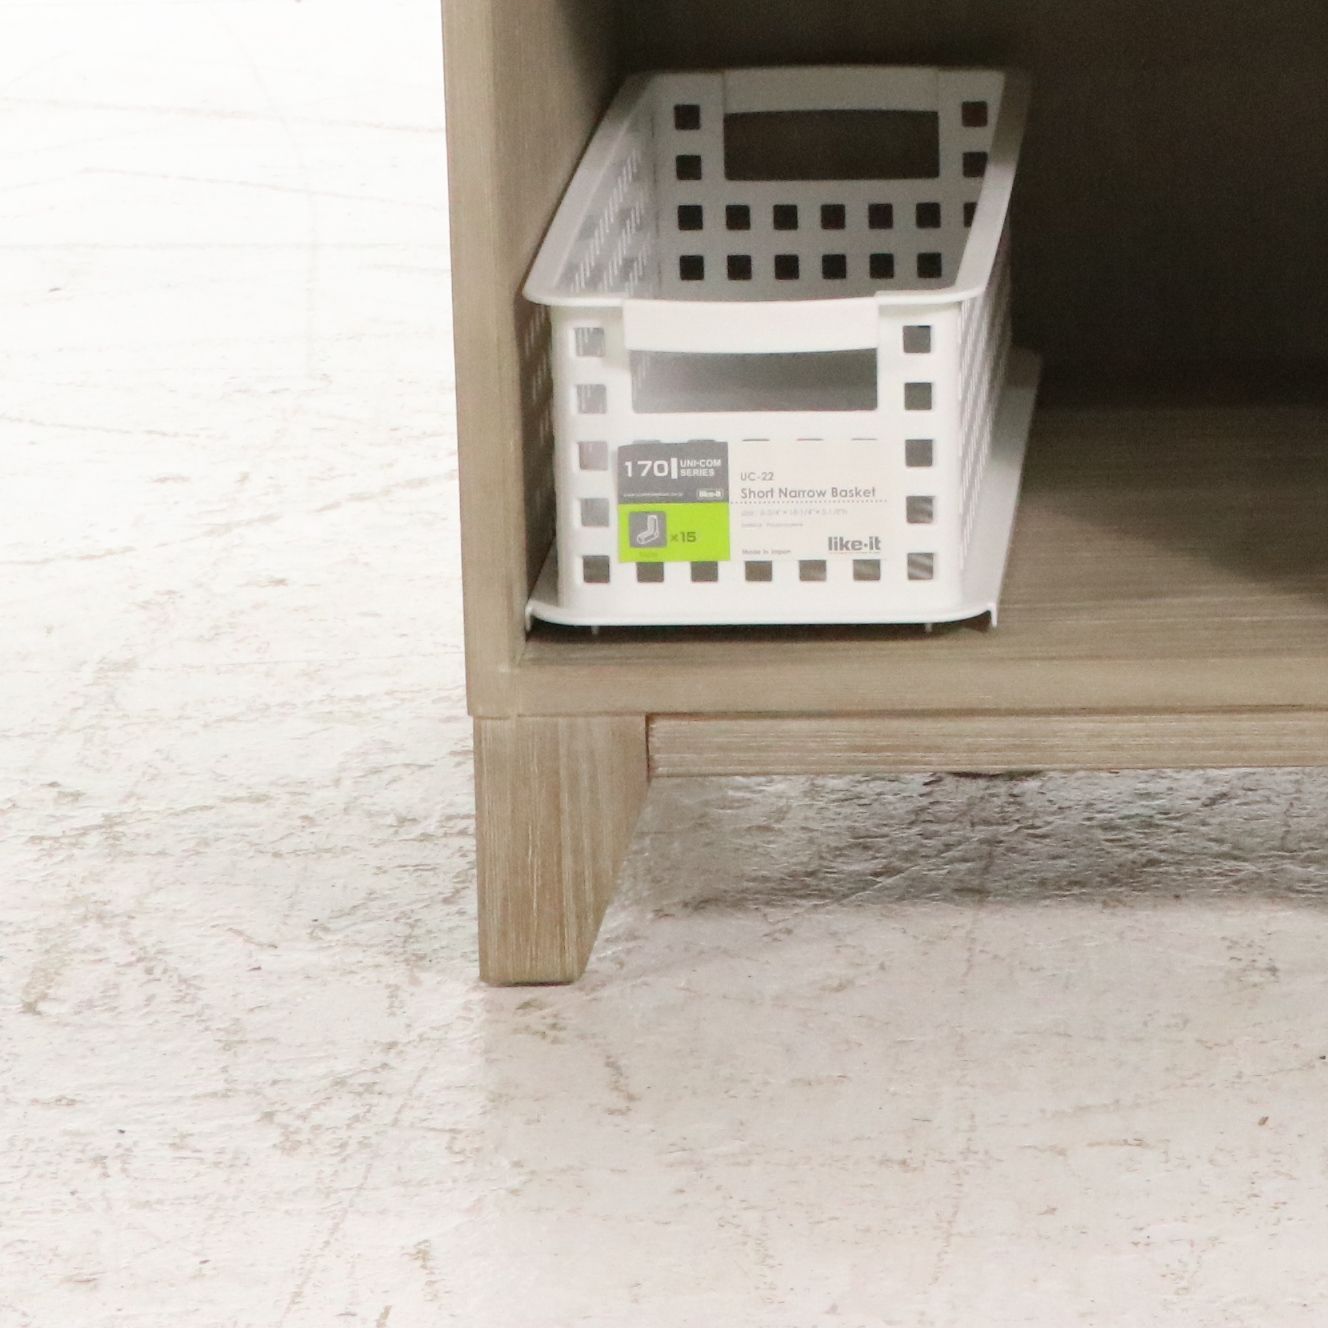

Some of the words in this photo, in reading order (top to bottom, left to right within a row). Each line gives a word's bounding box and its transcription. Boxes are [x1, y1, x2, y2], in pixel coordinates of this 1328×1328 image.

[680, 459, 721, 468] UNI-COM
[624, 460, 669, 477] 170
[680, 468, 715, 477] SERIES
[740, 472, 775, 481] UC-22
[740, 487, 774, 499] Short
[778, 487, 827, 498] Narrow
[831, 486, 877, 498] Basket
